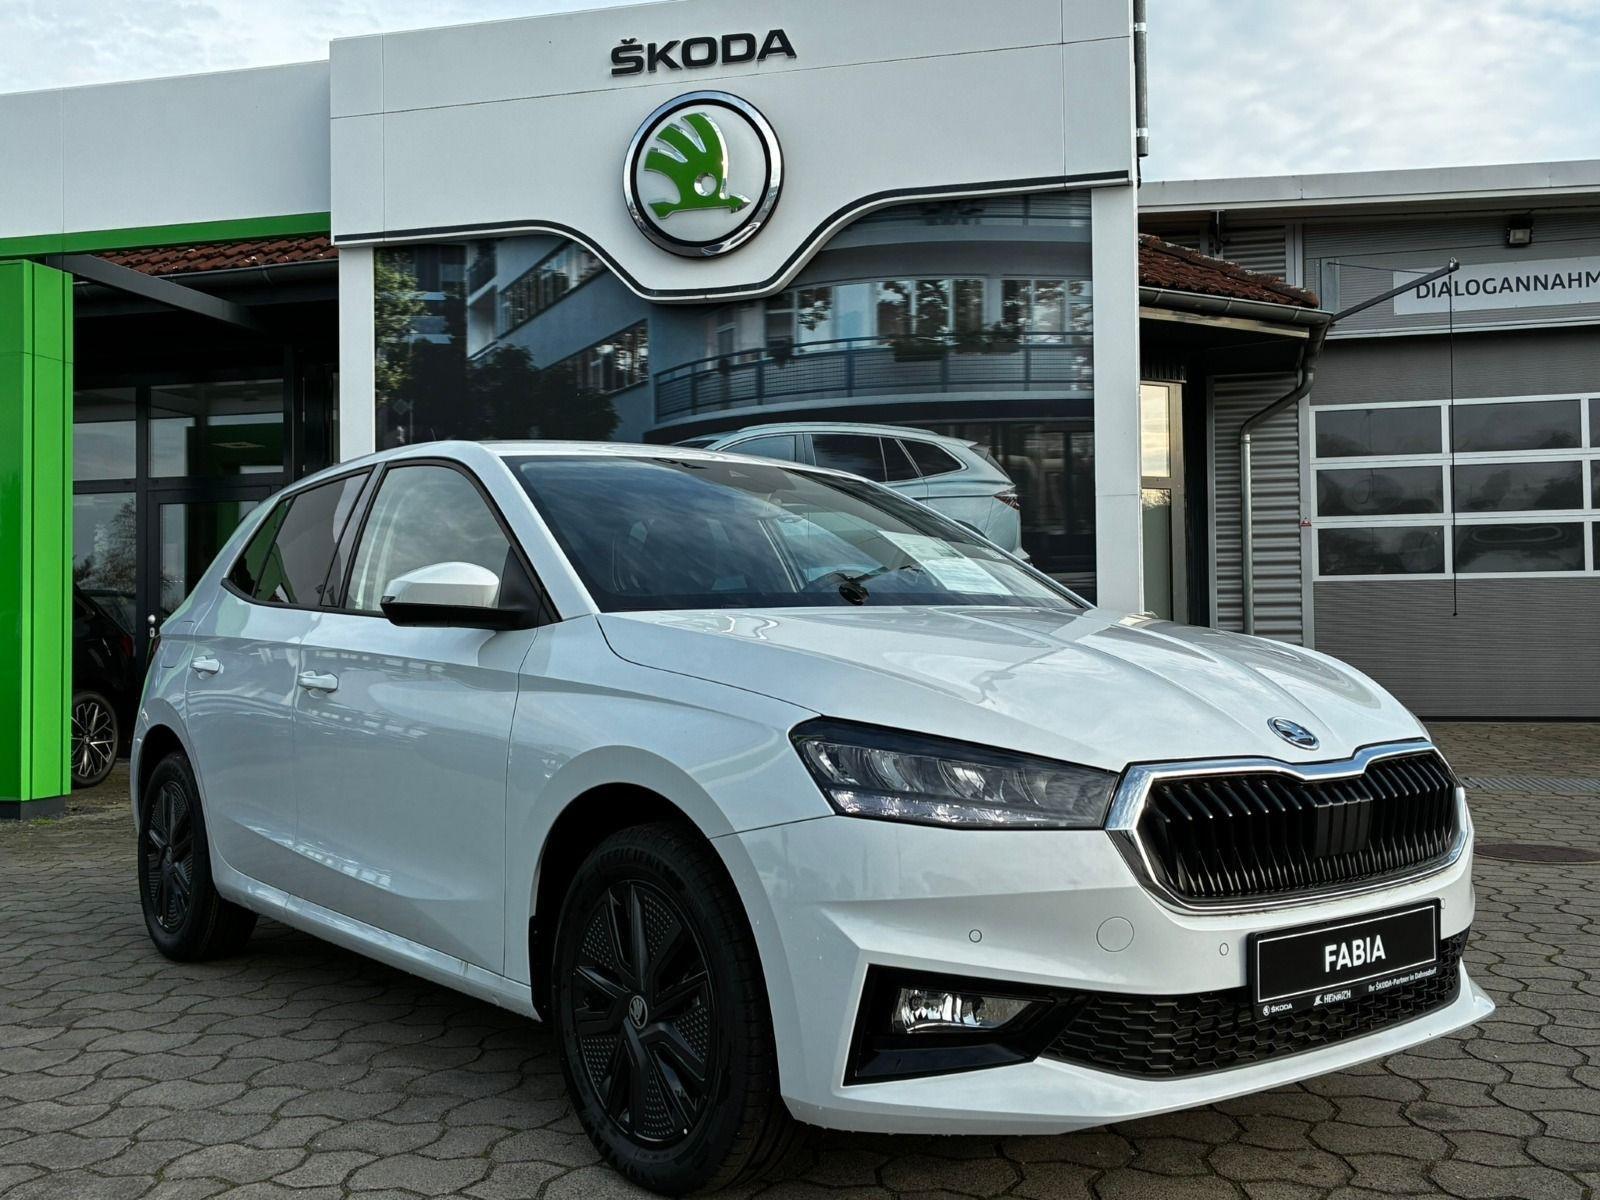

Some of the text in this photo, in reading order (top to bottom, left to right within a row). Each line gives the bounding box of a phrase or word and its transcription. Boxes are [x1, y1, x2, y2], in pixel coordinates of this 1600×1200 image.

[611, 28, 797, 77] ŠKODA
[1324, 934, 1386, 973] FABIA
[1270, 1003, 1293, 1013] ŠKODA
